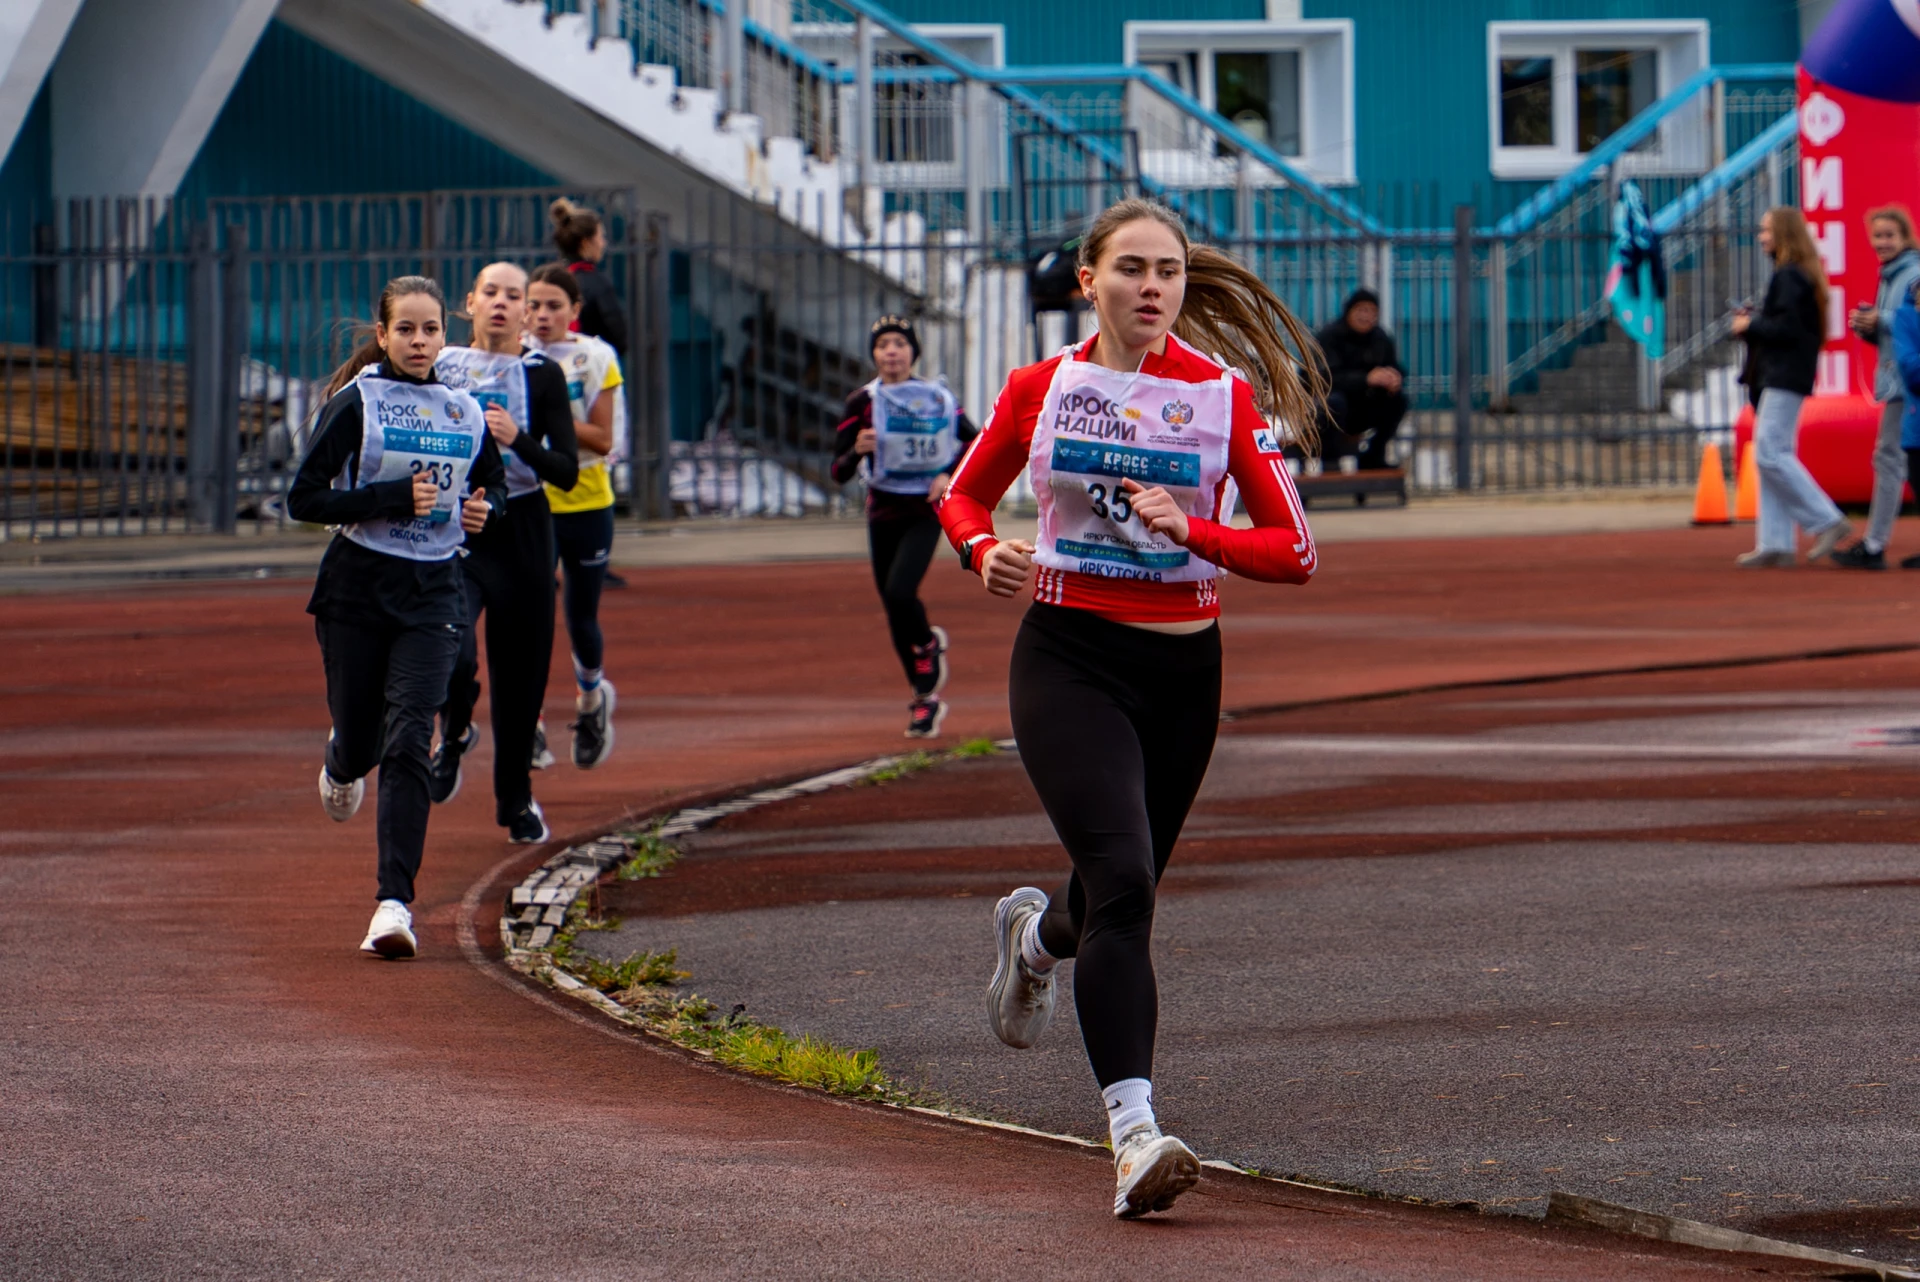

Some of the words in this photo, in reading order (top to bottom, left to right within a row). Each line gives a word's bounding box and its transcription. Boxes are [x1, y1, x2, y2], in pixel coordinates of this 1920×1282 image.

[1058, 393, 1119, 418] КРОСС
[1053, 413, 1137, 442] НАЦИИ
[1104, 451, 1149, 469] КРОСС
[1088, 482, 1132, 523] 35
[1083, 531, 1131, 548] ИРКУТСКАЯ
[1131, 541, 1167, 550] ОБЛАСТЬ
[1079, 560, 1161, 582] ИРКУТСКАЯ
